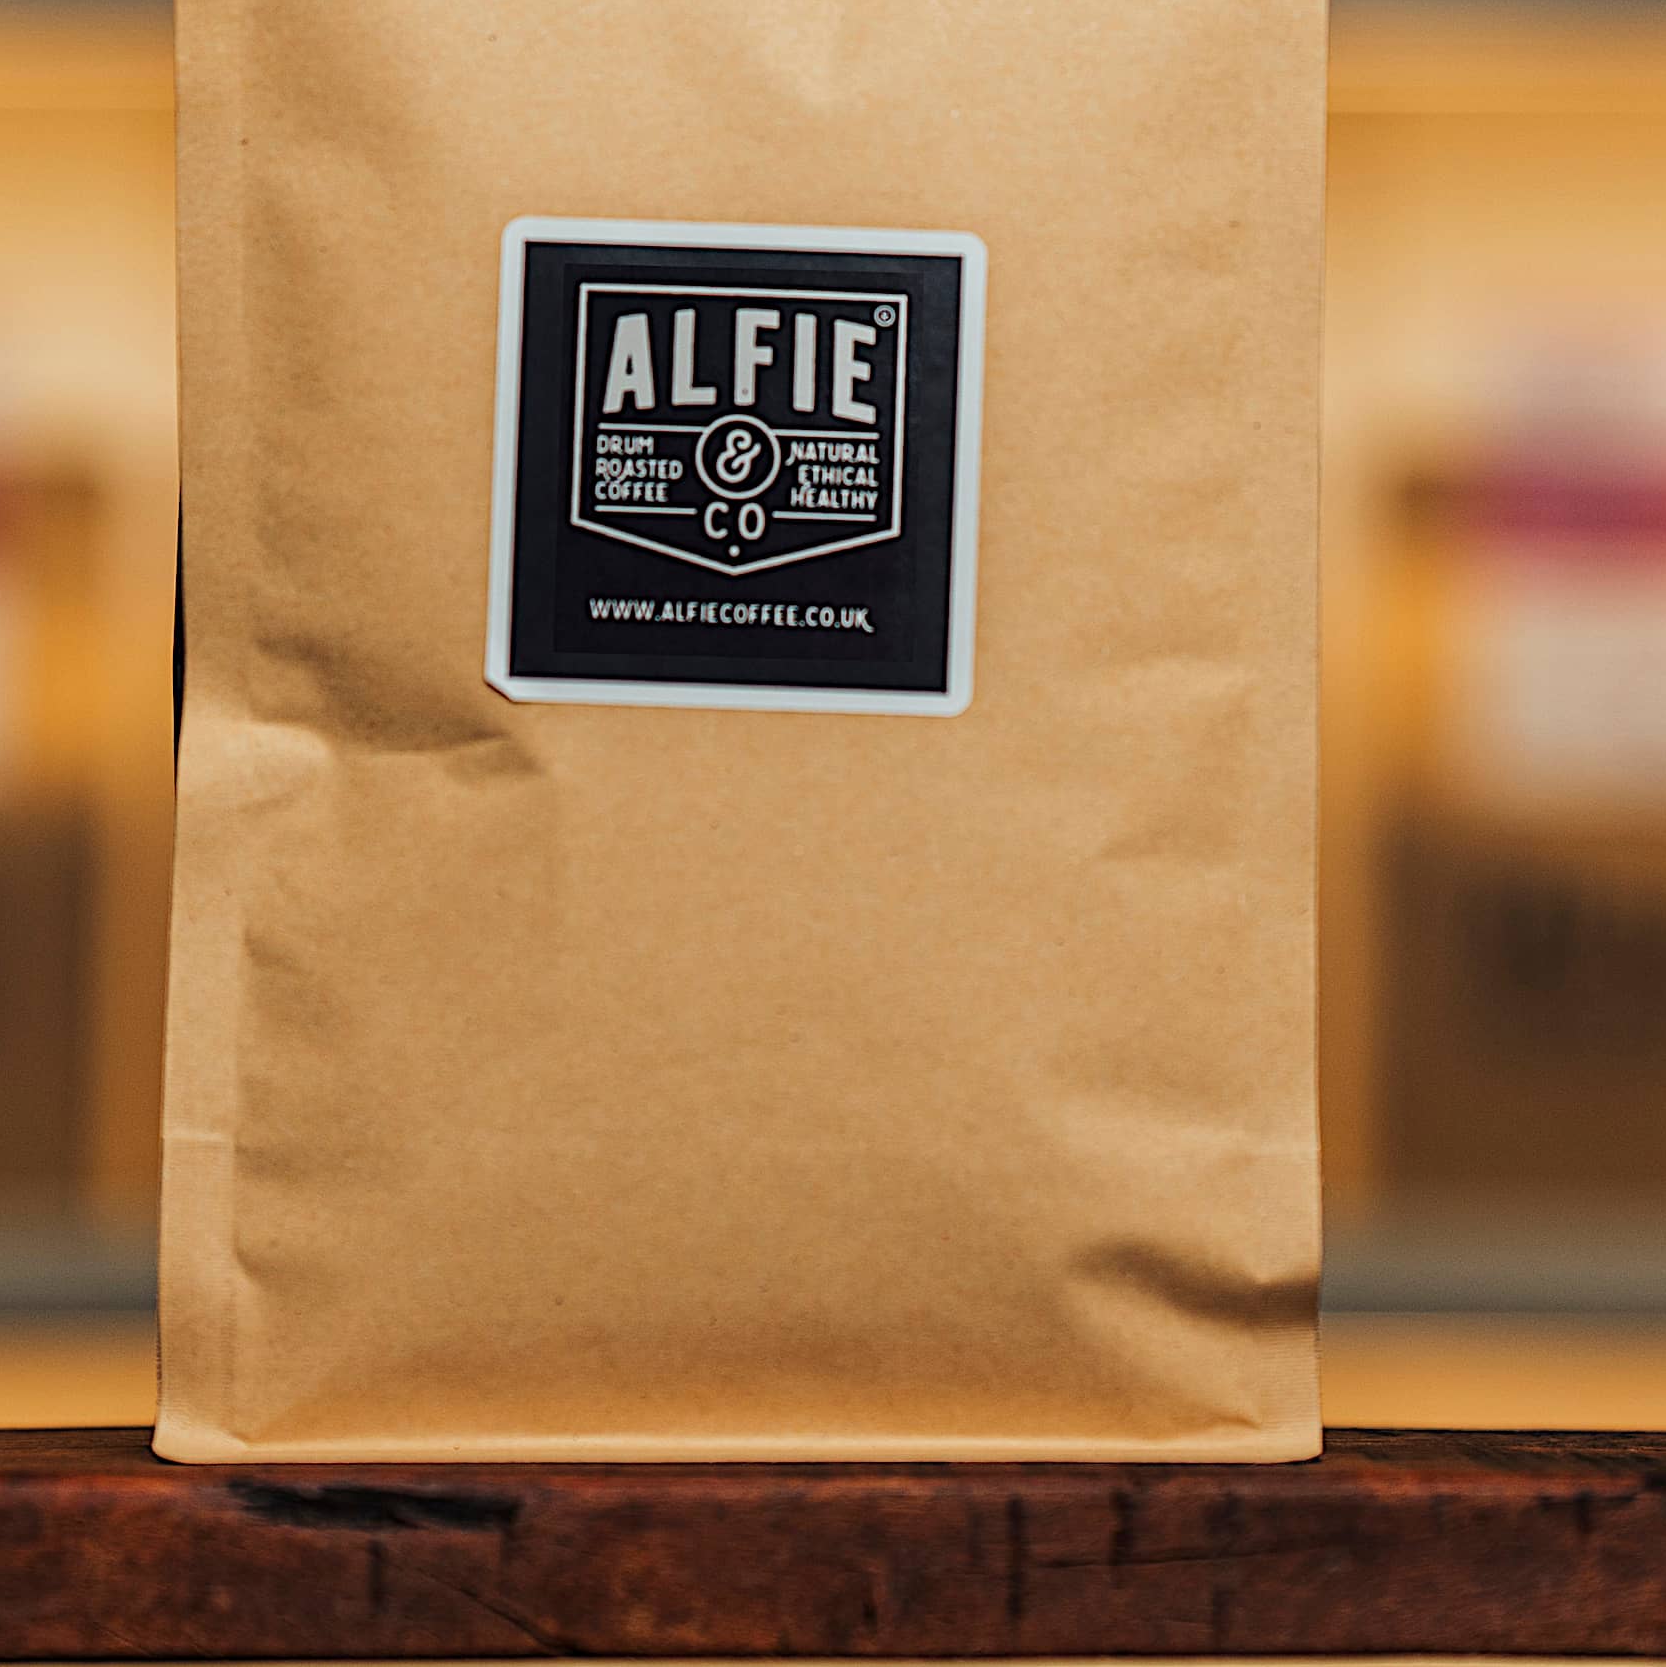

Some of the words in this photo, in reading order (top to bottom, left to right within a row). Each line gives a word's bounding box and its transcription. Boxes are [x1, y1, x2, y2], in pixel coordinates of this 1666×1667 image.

[602, 308, 877, 425] ALFIE
[596, 435, 654, 456] DRUM
[785, 442, 880, 466] NATURAL
[595, 458, 684, 483] ROASTED
[797, 465, 880, 488] ETHICAL
[595, 481, 669, 502] COFFEE
[790, 487, 879, 510] HEALTHY
[589, 598, 875, 633] WWW.ALFIECOFFEE.CO.UK
